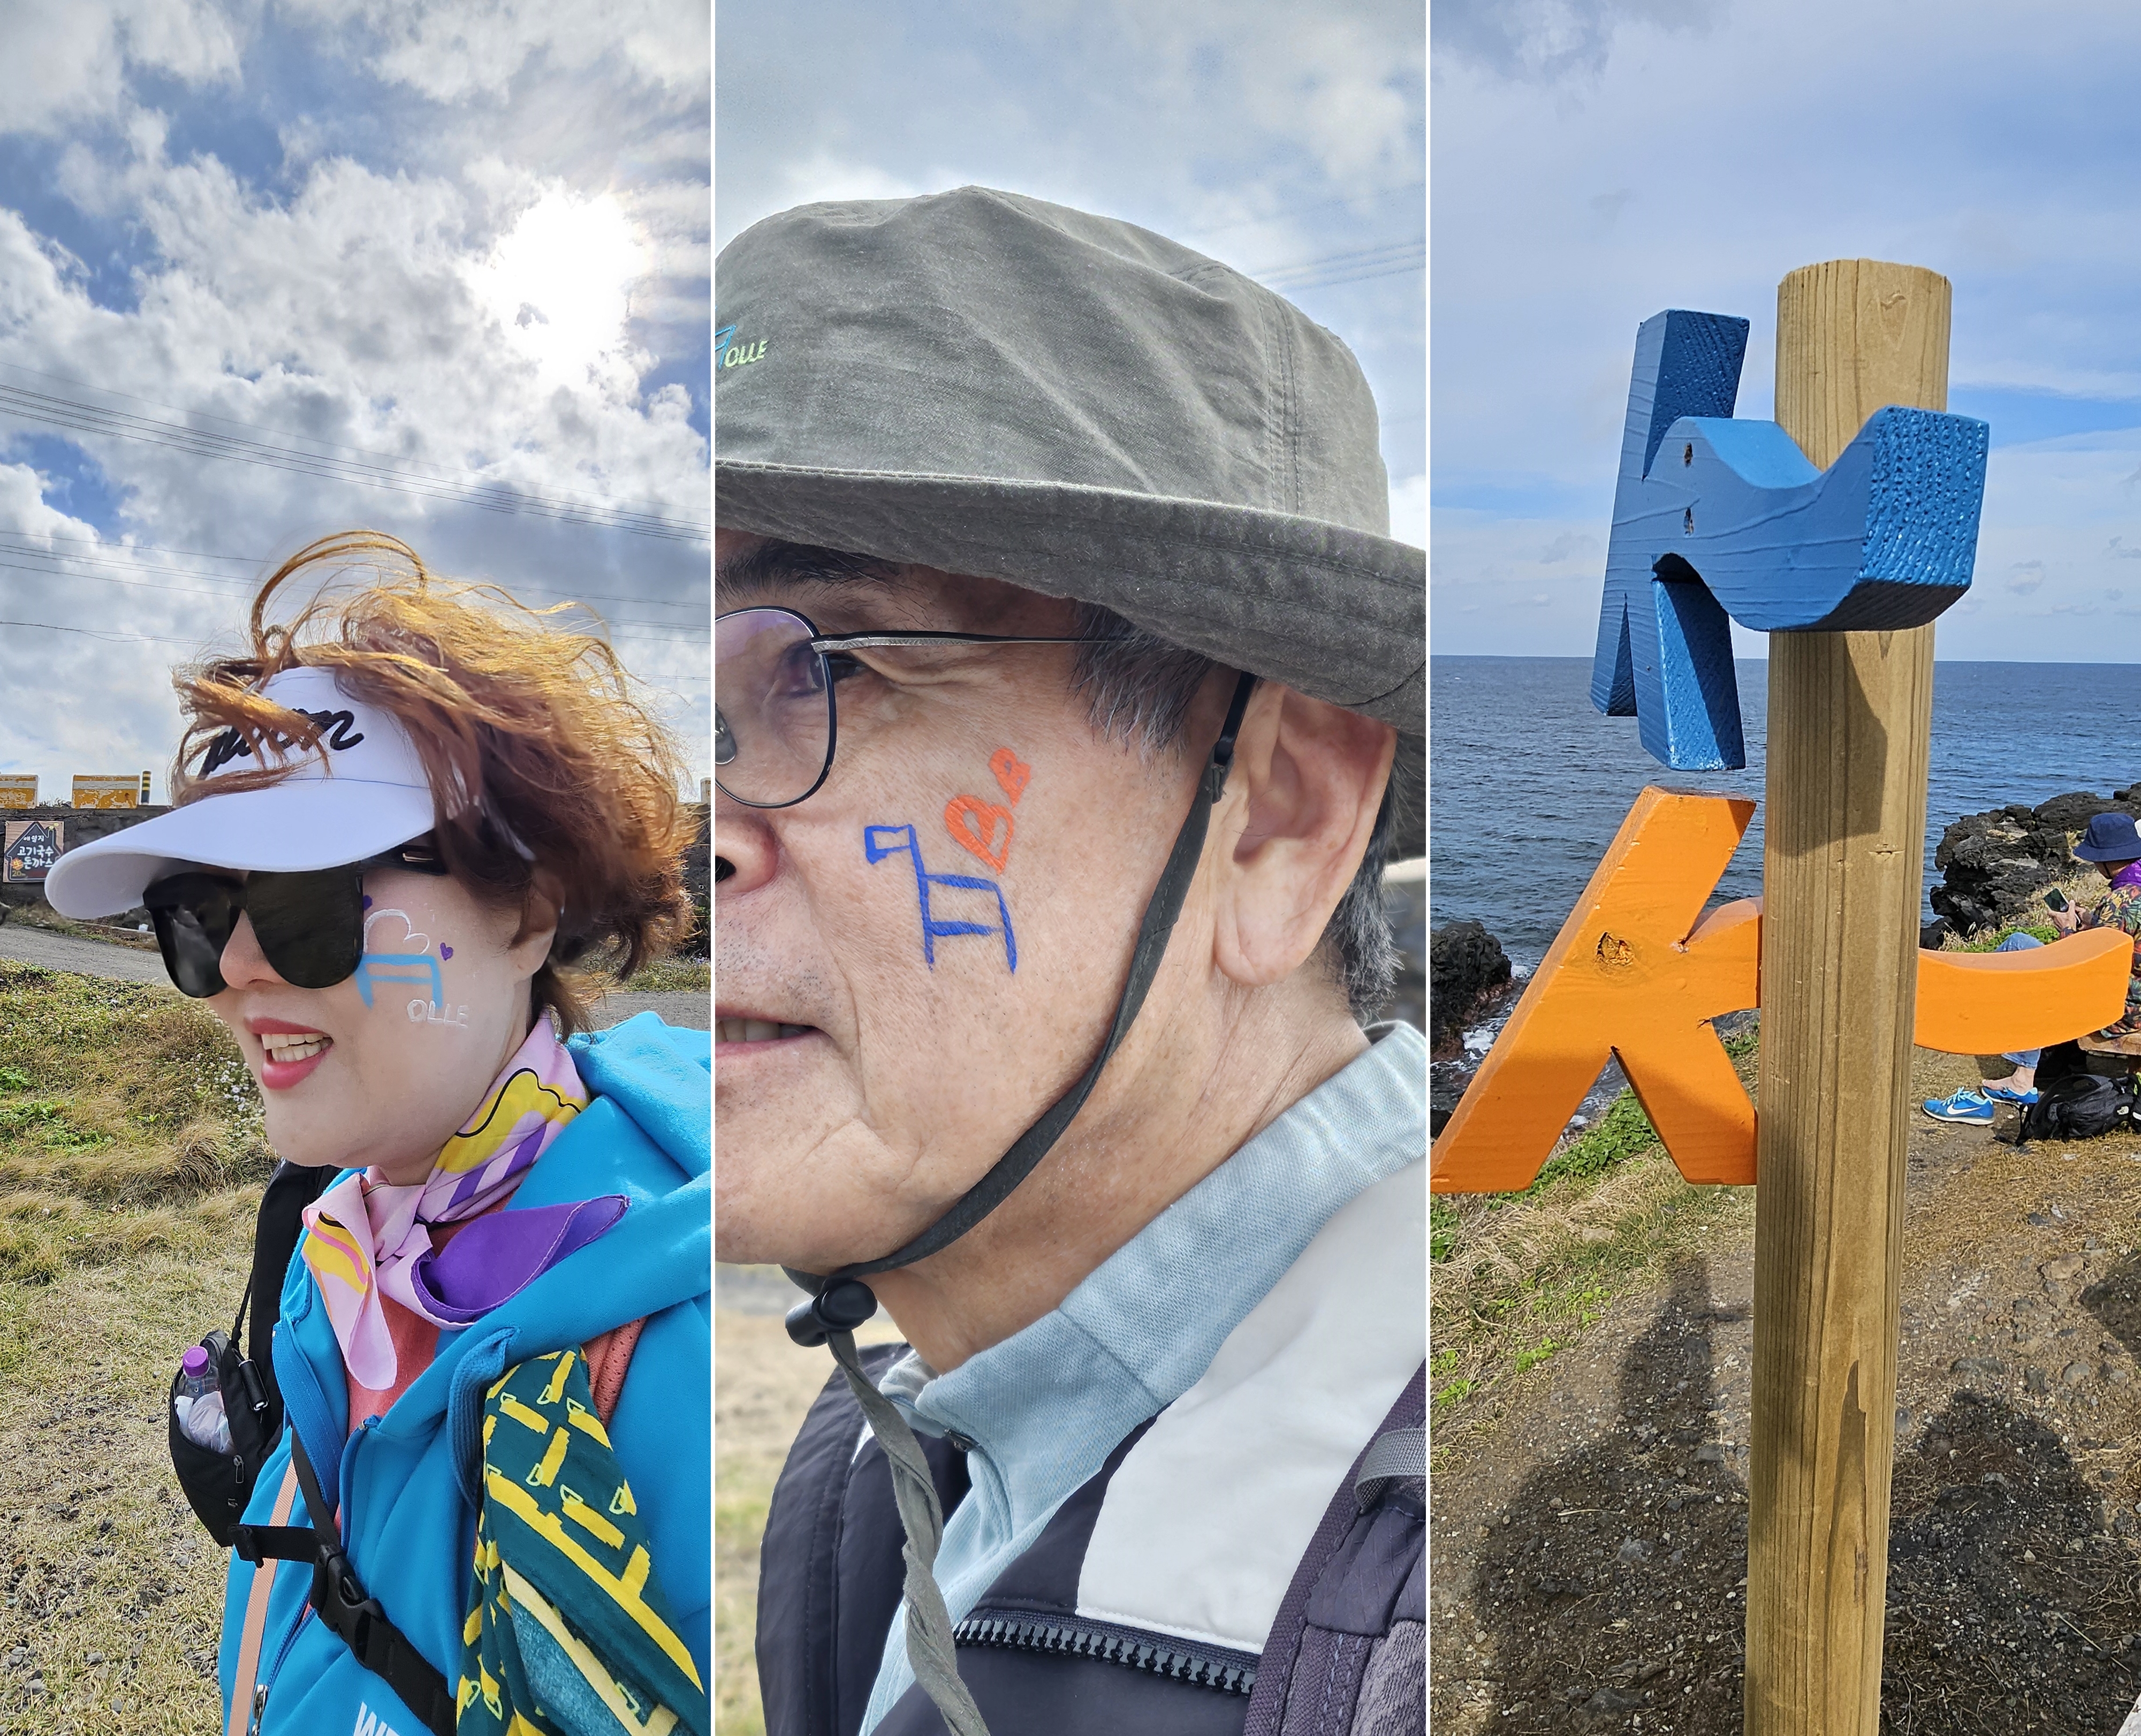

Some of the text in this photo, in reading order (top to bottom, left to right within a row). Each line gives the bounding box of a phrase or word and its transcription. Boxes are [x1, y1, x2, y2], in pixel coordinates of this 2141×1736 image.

[724, 339, 769, 368] OLLE
[23, 835, 44, 843] 애월집
[17, 845, 54, 858] 고기국수
[23, 856, 54, 869] 돈까스
[406, 998, 470, 1029] OLLE
